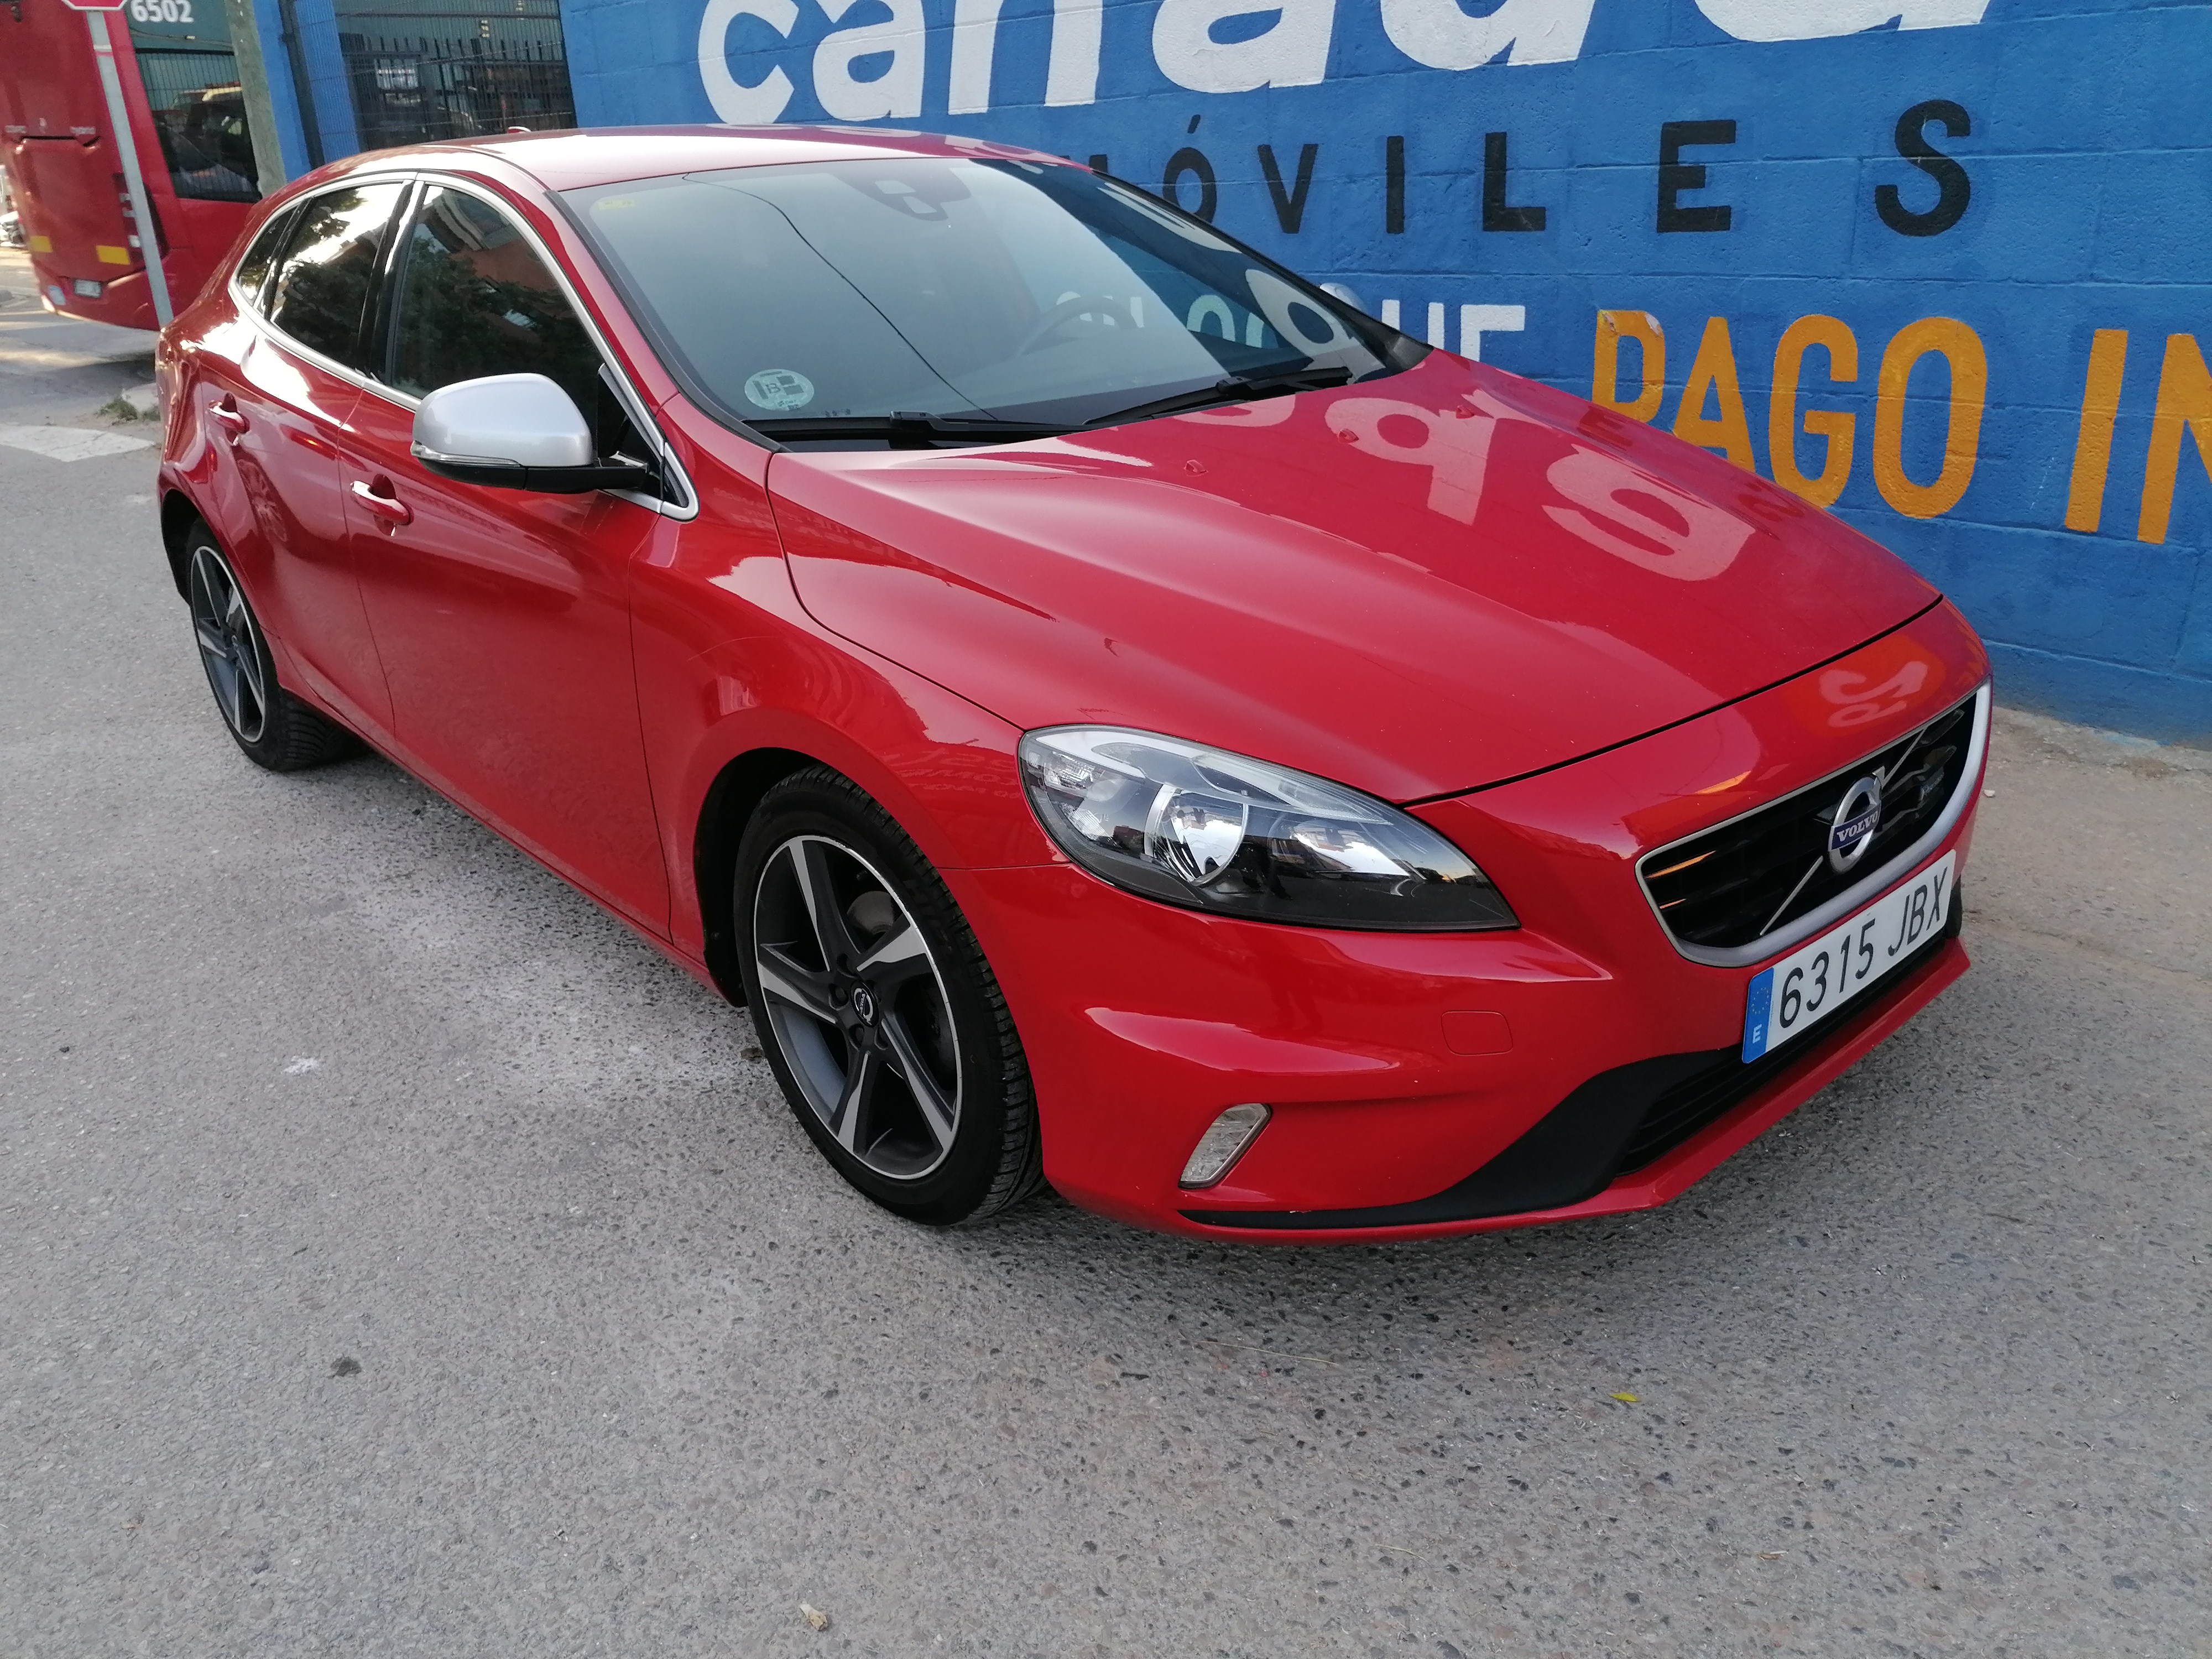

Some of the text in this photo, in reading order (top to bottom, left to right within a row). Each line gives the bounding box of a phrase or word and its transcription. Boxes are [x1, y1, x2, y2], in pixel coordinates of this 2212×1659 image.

[131, 0, 194, 23] 6502
[1061, 100, 1971, 237] ÓVILES
[1592, 310, 1988, 519] PAGO
[1837, 811, 1878, 842] VOLVO
[1779, 866, 1948, 1029] 6315 JBX
[1752, 1024, 1762, 1044] E
